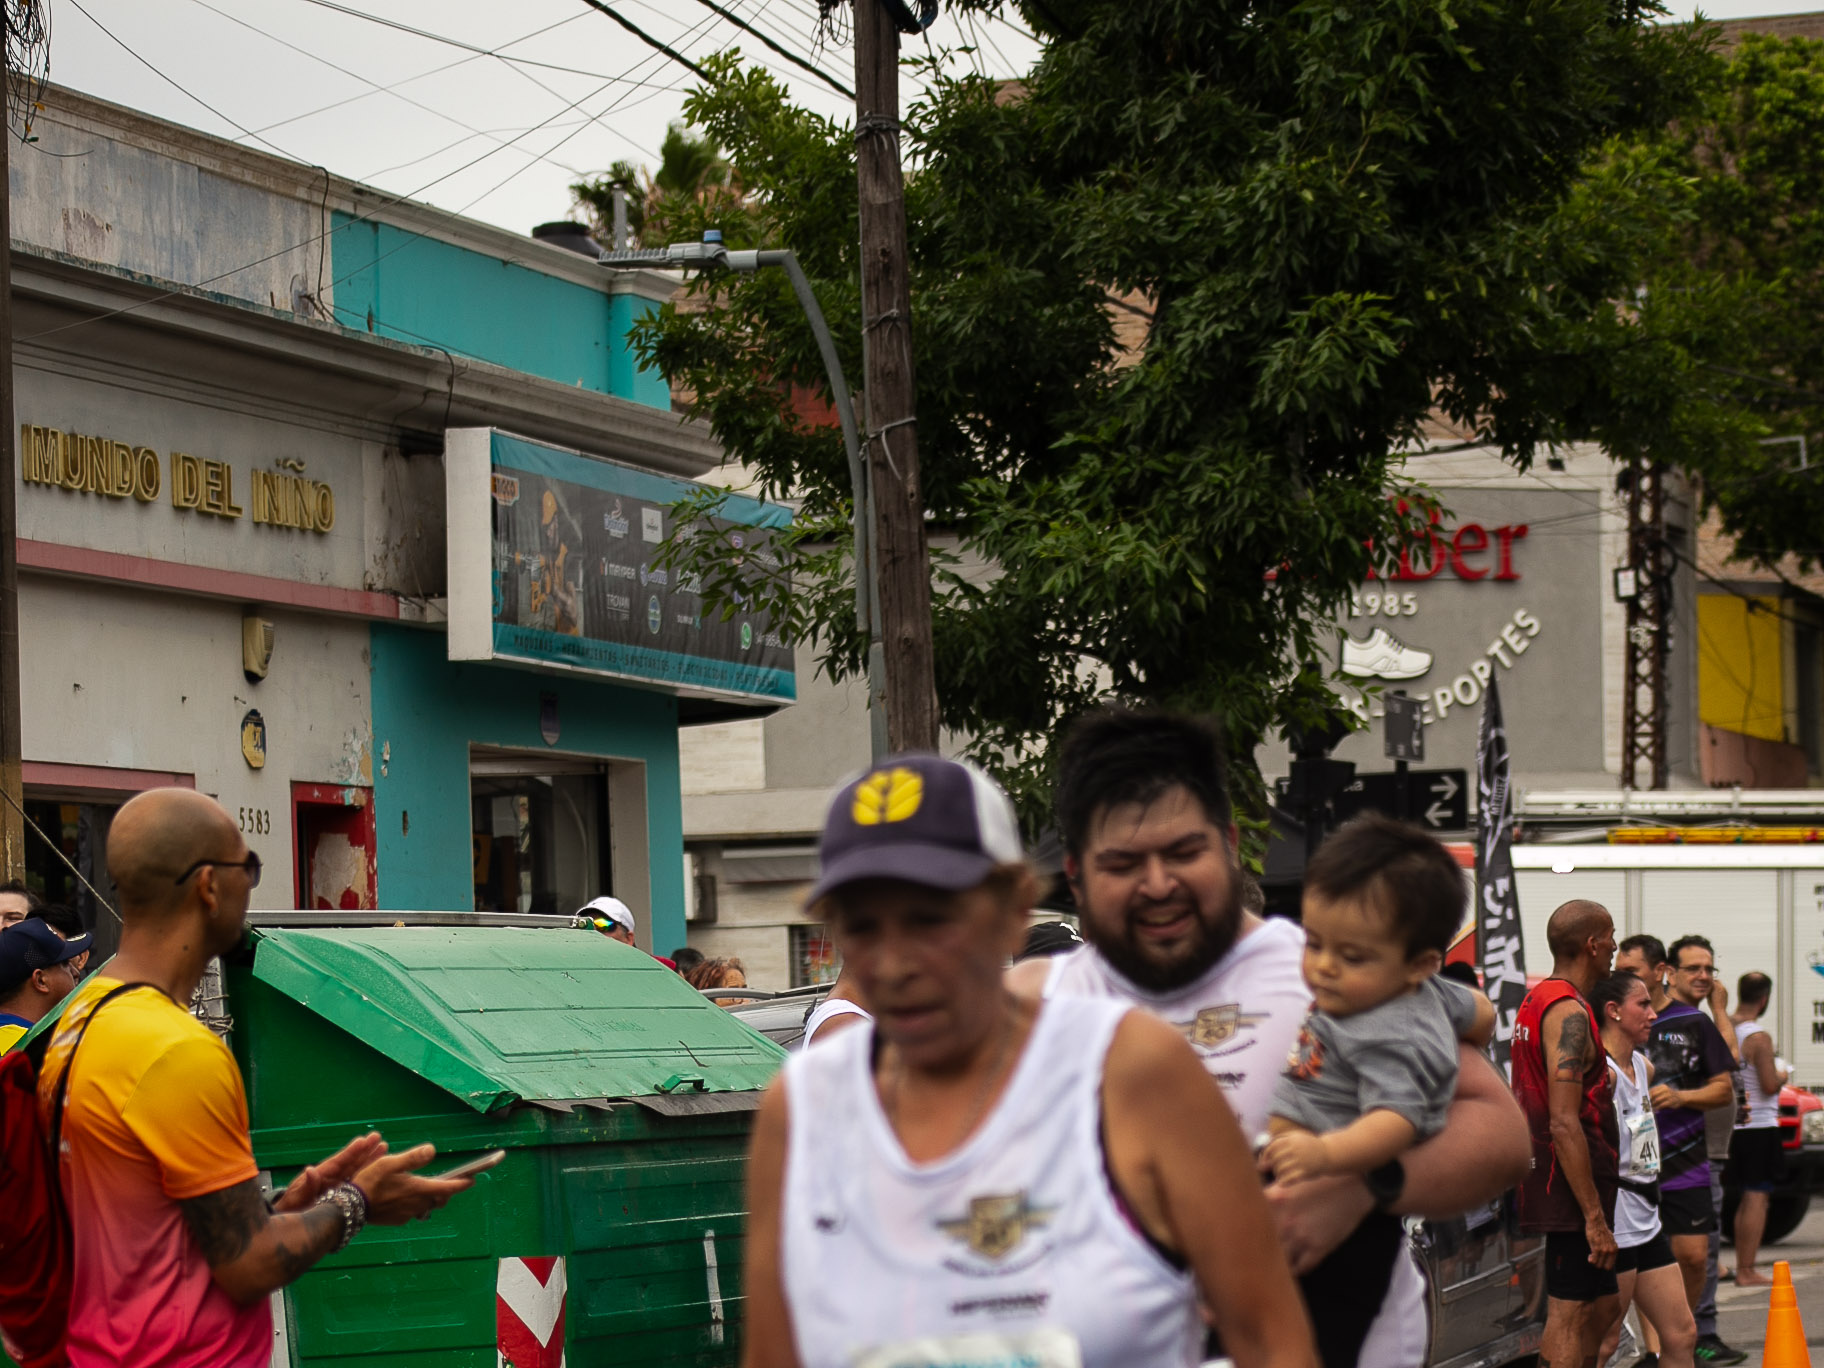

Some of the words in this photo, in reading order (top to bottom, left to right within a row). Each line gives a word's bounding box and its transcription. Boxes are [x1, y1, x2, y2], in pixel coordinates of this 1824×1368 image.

[22, 424, 161, 501] MUNDO
[171, 452, 243, 518] DEL
[252, 457, 334, 533] NIÑO
[1414, 607, 1542, 725] EPORTES
[240, 806, 270, 835] 5583
